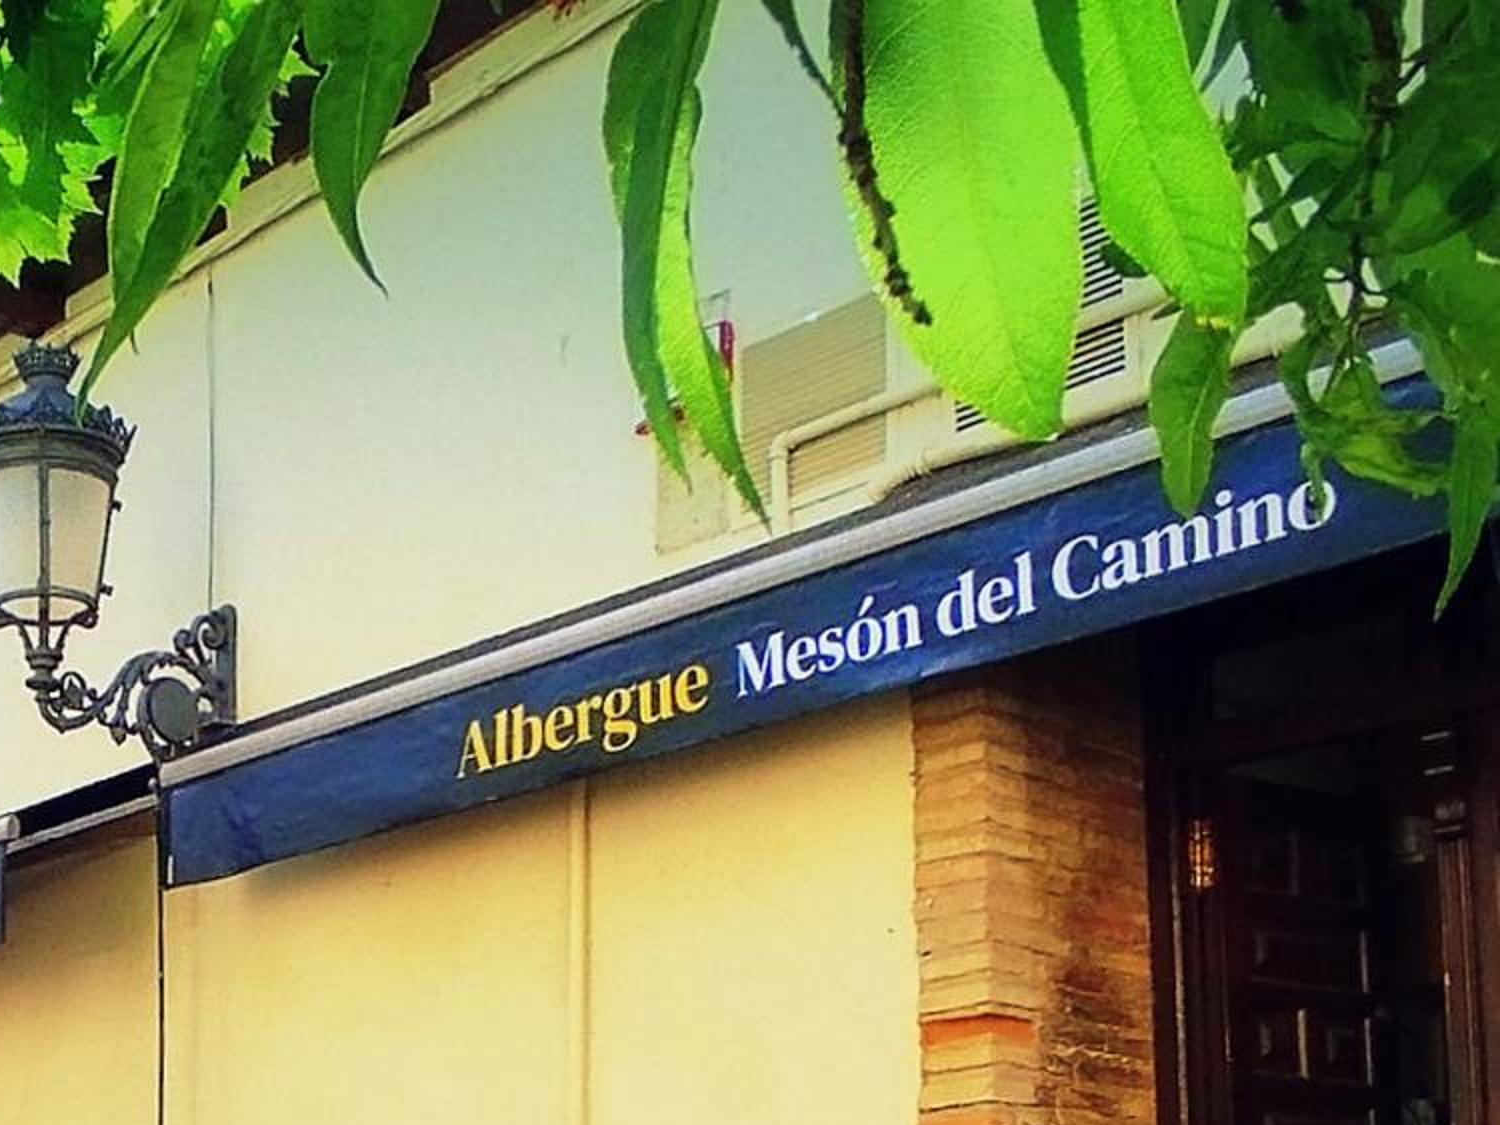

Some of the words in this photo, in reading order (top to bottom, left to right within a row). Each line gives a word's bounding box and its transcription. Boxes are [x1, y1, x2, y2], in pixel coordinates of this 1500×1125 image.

[456, 664, 710, 780] Albergue
[735, 595, 924, 699] Mesón
[936, 550, 1038, 638] del
[1051, 479, 1337, 601] Camino
